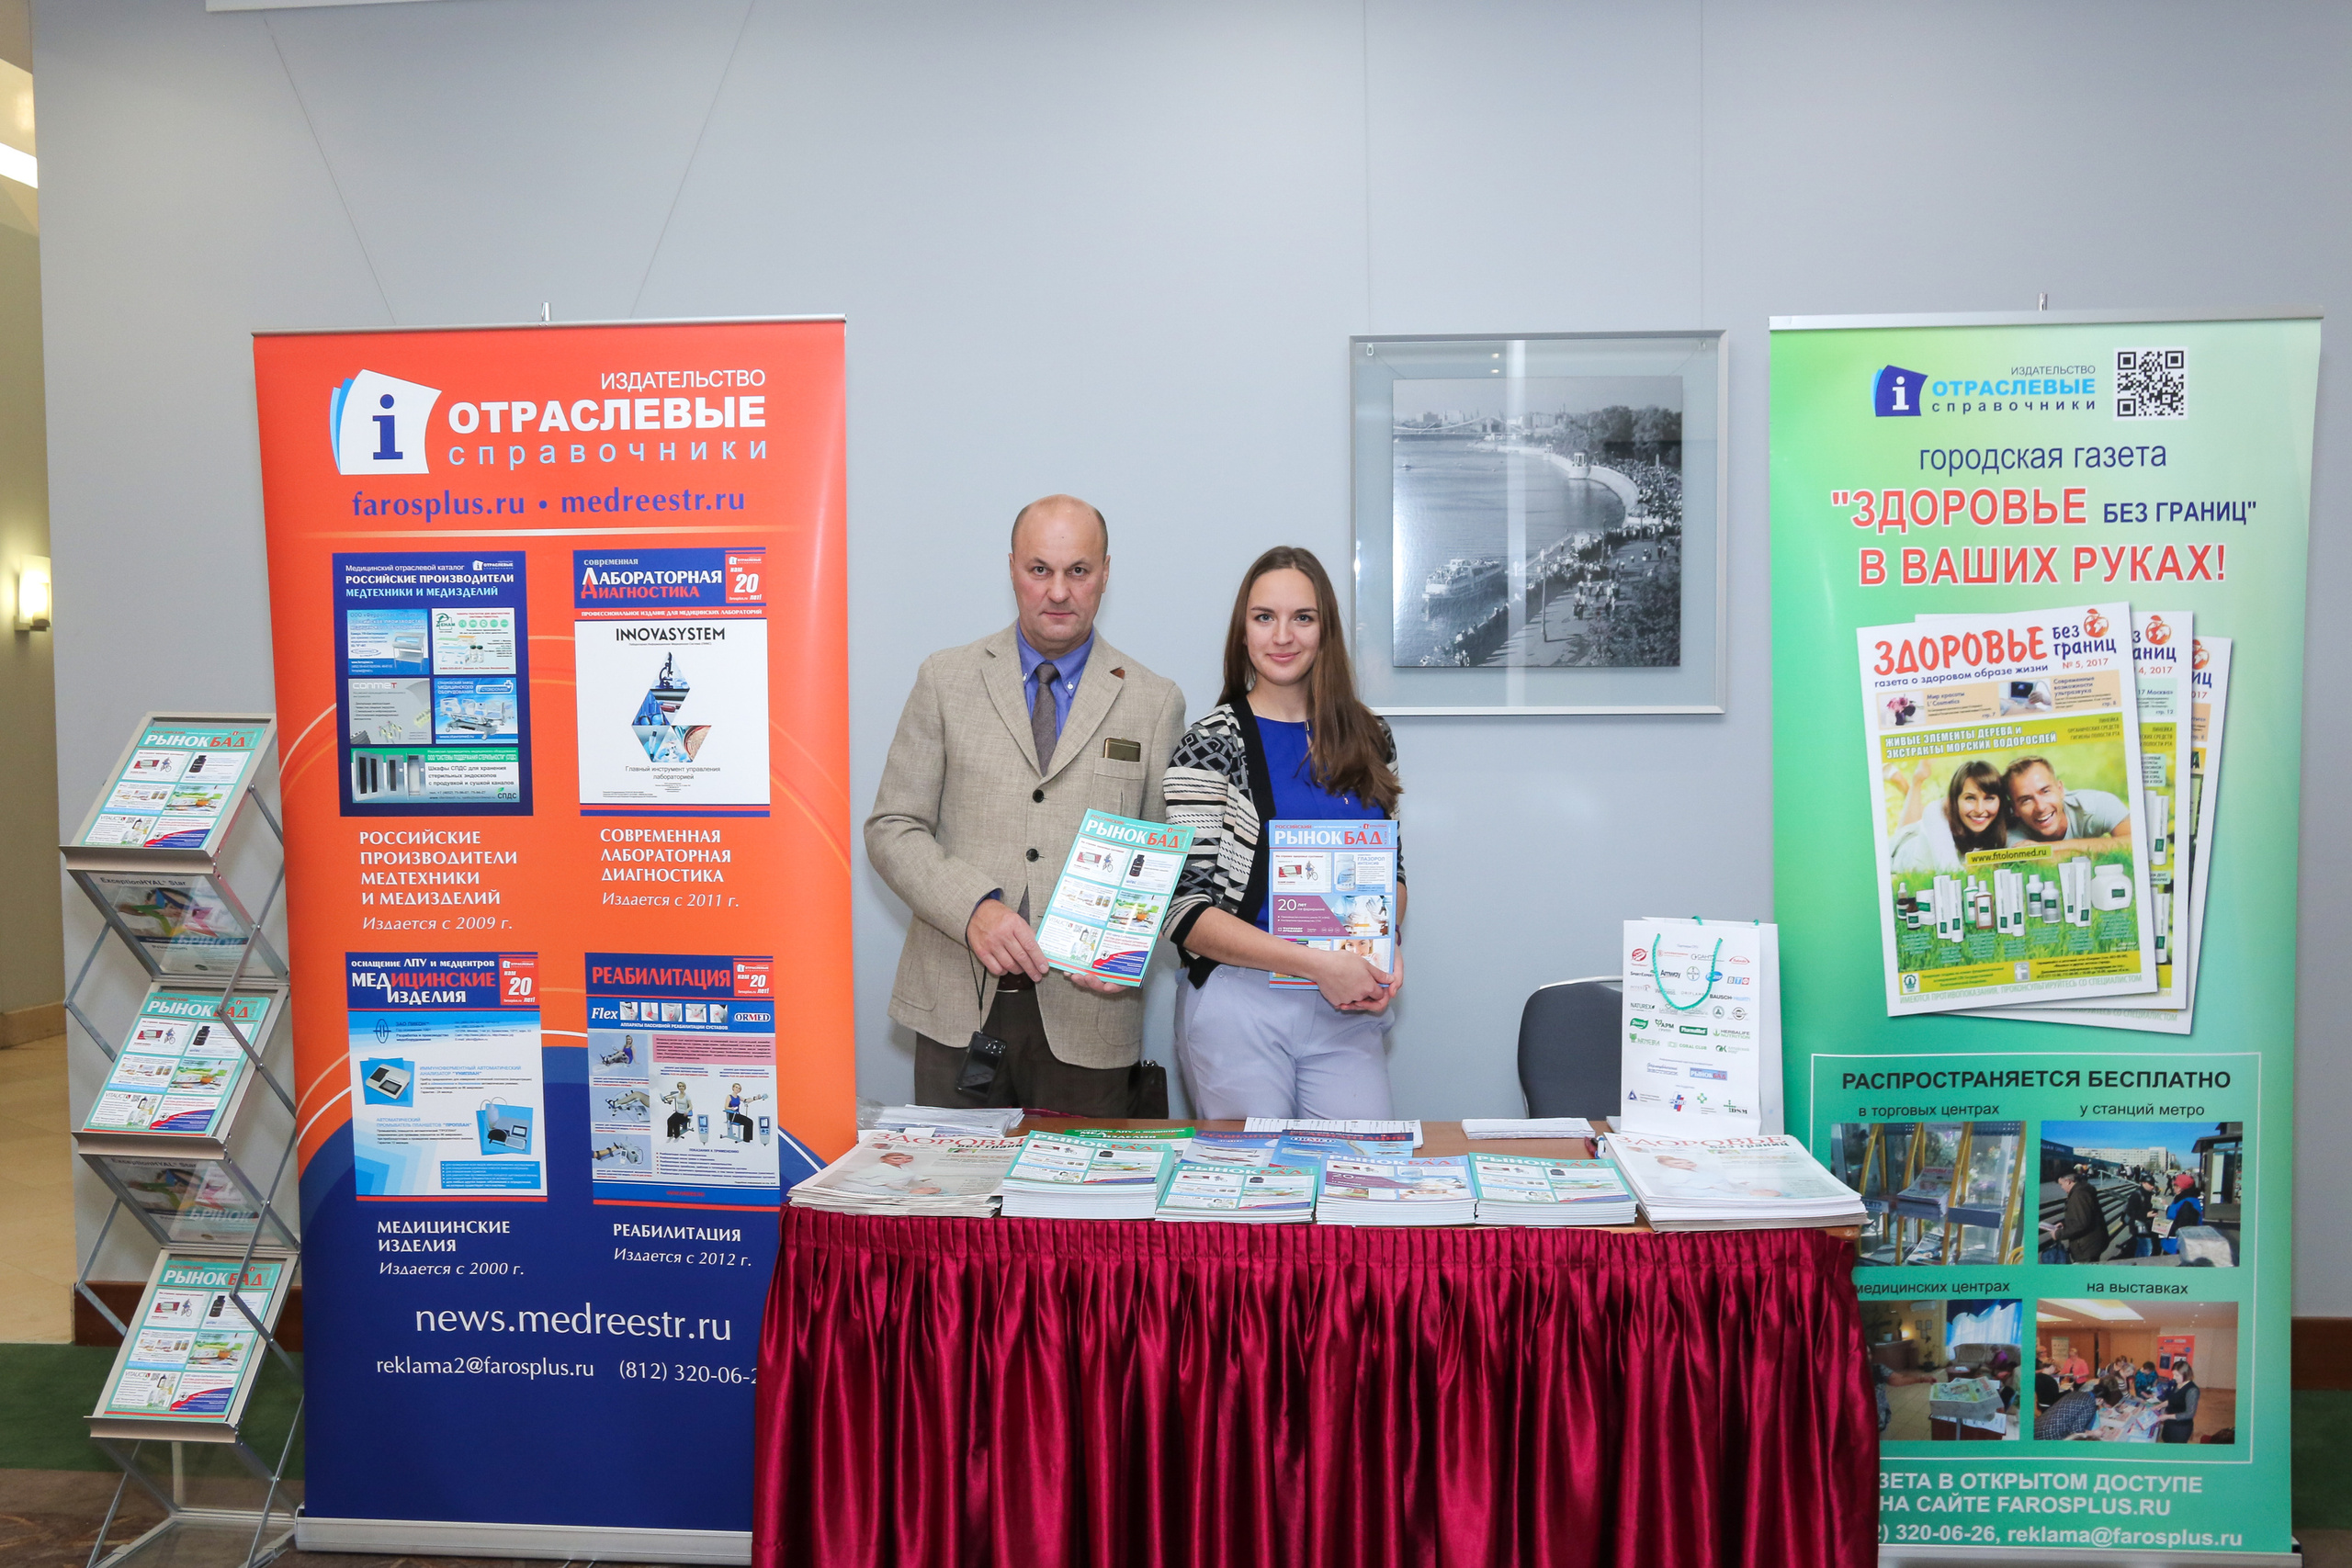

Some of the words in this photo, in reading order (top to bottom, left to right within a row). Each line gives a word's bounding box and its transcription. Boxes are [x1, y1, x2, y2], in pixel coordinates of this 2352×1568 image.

[2010, 365, 2096, 377] ИЗДАТЕЛЬСТВО
[601, 369, 765, 392] ИЗДАТЕЛЬСТВО
[1932, 378, 2096, 398] ОТРАСЛЕВЫЕ
[447, 395, 766, 434] ОТРАСЛЕВЫЕ
[1932, 400, 2096, 414] справочники
[448, 439, 767, 471] справочники
[1920, 446, 2063, 477] городская
[2074, 441, 2167, 469] газета
[352, 490, 525, 522] farosplus.ru
[561, 486, 745, 513] medreestr.ru
[1831, 487, 2089, 535] "ЗДОРОВЬЕ
[2102, 502, 2149, 524] БЕЗ
[2155, 500, 2257, 524] ГРАНИЦ"
[1860, 548, 1886, 586] В
[1901, 546, 2060, 586] ВАШИХ
[2073, 544, 2226, 584] РУКАХ!
[345, 574, 416, 584] РОССИЙСКИЕ
[420, 574, 514, 584] ПРОИЗВОДИТЕЛИ
[582, 568, 722, 585] ЛАБОРАТОРНАЯ
[734, 573, 759, 593] 20
[346, 588, 413, 598] МЕДТЕХНИКИ
[426, 586, 498, 597] МЕДИЗДЕЛИЙ
[581, 581, 700, 599] ДИАГНОСТИКА
[616, 627, 725, 641] INNOVASYSTEM
[1874, 626, 2048, 676] ЗДОРОВЬЕ
[2053, 638, 2116, 660] границ
[2075, 660, 2084, 670] 5,
[2086, 658, 2109, 667] 2017
[1874, 678, 1908, 688] газета
[1921, 672, 1972, 683] здоровом
[1974, 667, 2012, 679] образе
[2016, 664, 2049, 673] жизни
[1885, 735, 1921, 748] ЖИВЫЕ
[1924, 730, 1974, 743] ЭЛЕМЕНТЫ
[1978, 726, 2012, 739] ДЕРЕВА
[1886, 745, 1944, 759] ЭКСТРАКТЫ
[1947, 739, 1991, 752] МОРСКИХ
[1994, 731, 2057, 749] ВОДОРОСЛЕЙ
[359, 829, 481, 845] РОССИЙСКИЕ
[600, 829, 721, 843] СОВРЕМЕННАЯ
[360, 851, 518, 865] ПРОИЗВОДИТЕЛИ
[601, 849, 731, 863] ЛАБОРАТОРНАЯ
[1972, 848, 2047, 863] www.fitolonmed.ru
[361, 871, 480, 886] МЕДТЕХНИКИ
[601, 869, 724, 883] ДИАГНОСТИКА
[362, 892, 375, 905] И
[379, 888, 501, 906] МЕДИЗДЕЛИЙ
[602, 892, 670, 908] Издается
[674, 897, 684, 907] с
[686, 893, 722, 908] 2011
[729, 897, 740, 908] г.
[1278, 899, 1296, 911] 20
[362, 917, 436, 931] Издается
[442, 919, 450, 930] с
[456, 917, 496, 931] 2009
[501, 919, 513, 930] г.
[403, 959, 426, 967] ЛПУ
[352, 973, 496, 989] МЕДИЦИНСКИЕ
[593, 967, 730, 989] РЕАБИЛИТАЦИЯ
[750, 975, 766, 987] 20
[1660, 970, 1681, 978] Amway
[508, 976, 532, 996] 20
[1900, 994, 1930, 1004] ИМЕЮТСЯ
[2089, 975, 2143, 986] СПЕЦИАЛИСТОМ
[387, 989, 466, 1005] ИЗДЕЛИЯ
[592, 1007, 617, 1020] Flex
[735, 1013, 770, 1021] ORMED
[1842, 1071, 2080, 1090] РАСПРОСТРАНЯЕТСЯ
[2088, 1070, 2231, 1089] БЕСПЛАТНО
[1859, 1106, 1867, 1116] в
[1871, 1104, 1938, 1118] торговых
[1941, 1103, 1999, 1117] центрах
[2080, 1106, 2087, 1117] у
[2092, 1104, 2154, 1117] станций
[2159, 1106, 2205, 1117] метро
[378, 1221, 511, 1235] МЕДИЦИНСКИЕ
[613, 1224, 741, 1243] РЕАБИЛИТАЦИЯ
[379, 1239, 457, 1253] ИЗДЕЛИЯ
[614, 1247, 682, 1264] Издается
[685, 1253, 694, 1264] с
[699, 1251, 736, 1267] 2012
[741, 1256, 752, 1267] г.
[379, 1261, 451, 1277] Издается
[457, 1265, 465, 1275] с
[469, 1262, 508, 1276] 2000
[514, 1265, 525, 1275] г.
[1951, 1280, 2010, 1294] центрах
[2086, 1282, 2104, 1293] на
[2109, 1282, 2188, 1294] выставках
[415, 1303, 731, 1341] news.medreestr.ru
[377, 1356, 594, 1381] reklama2@farosplus.ru
[619, 1359, 667, 1382] (812)
[1939, 1473, 1953, 1490] В
[1960, 1472, 2087, 1491] ОТКРЫТОМ
[2094, 1474, 2203, 1494] ДОСТУПЕ
[1879, 1496, 1908, 1513] НА
[1916, 1493, 1990, 1513] САЙТЕ
[1997, 1495, 2171, 1517] FAROSPLUS.RU
[1895, 1524, 2001, 1544] 320-06-26,
[2007, 1527, 2243, 1548] reklama@farosplus.ru
